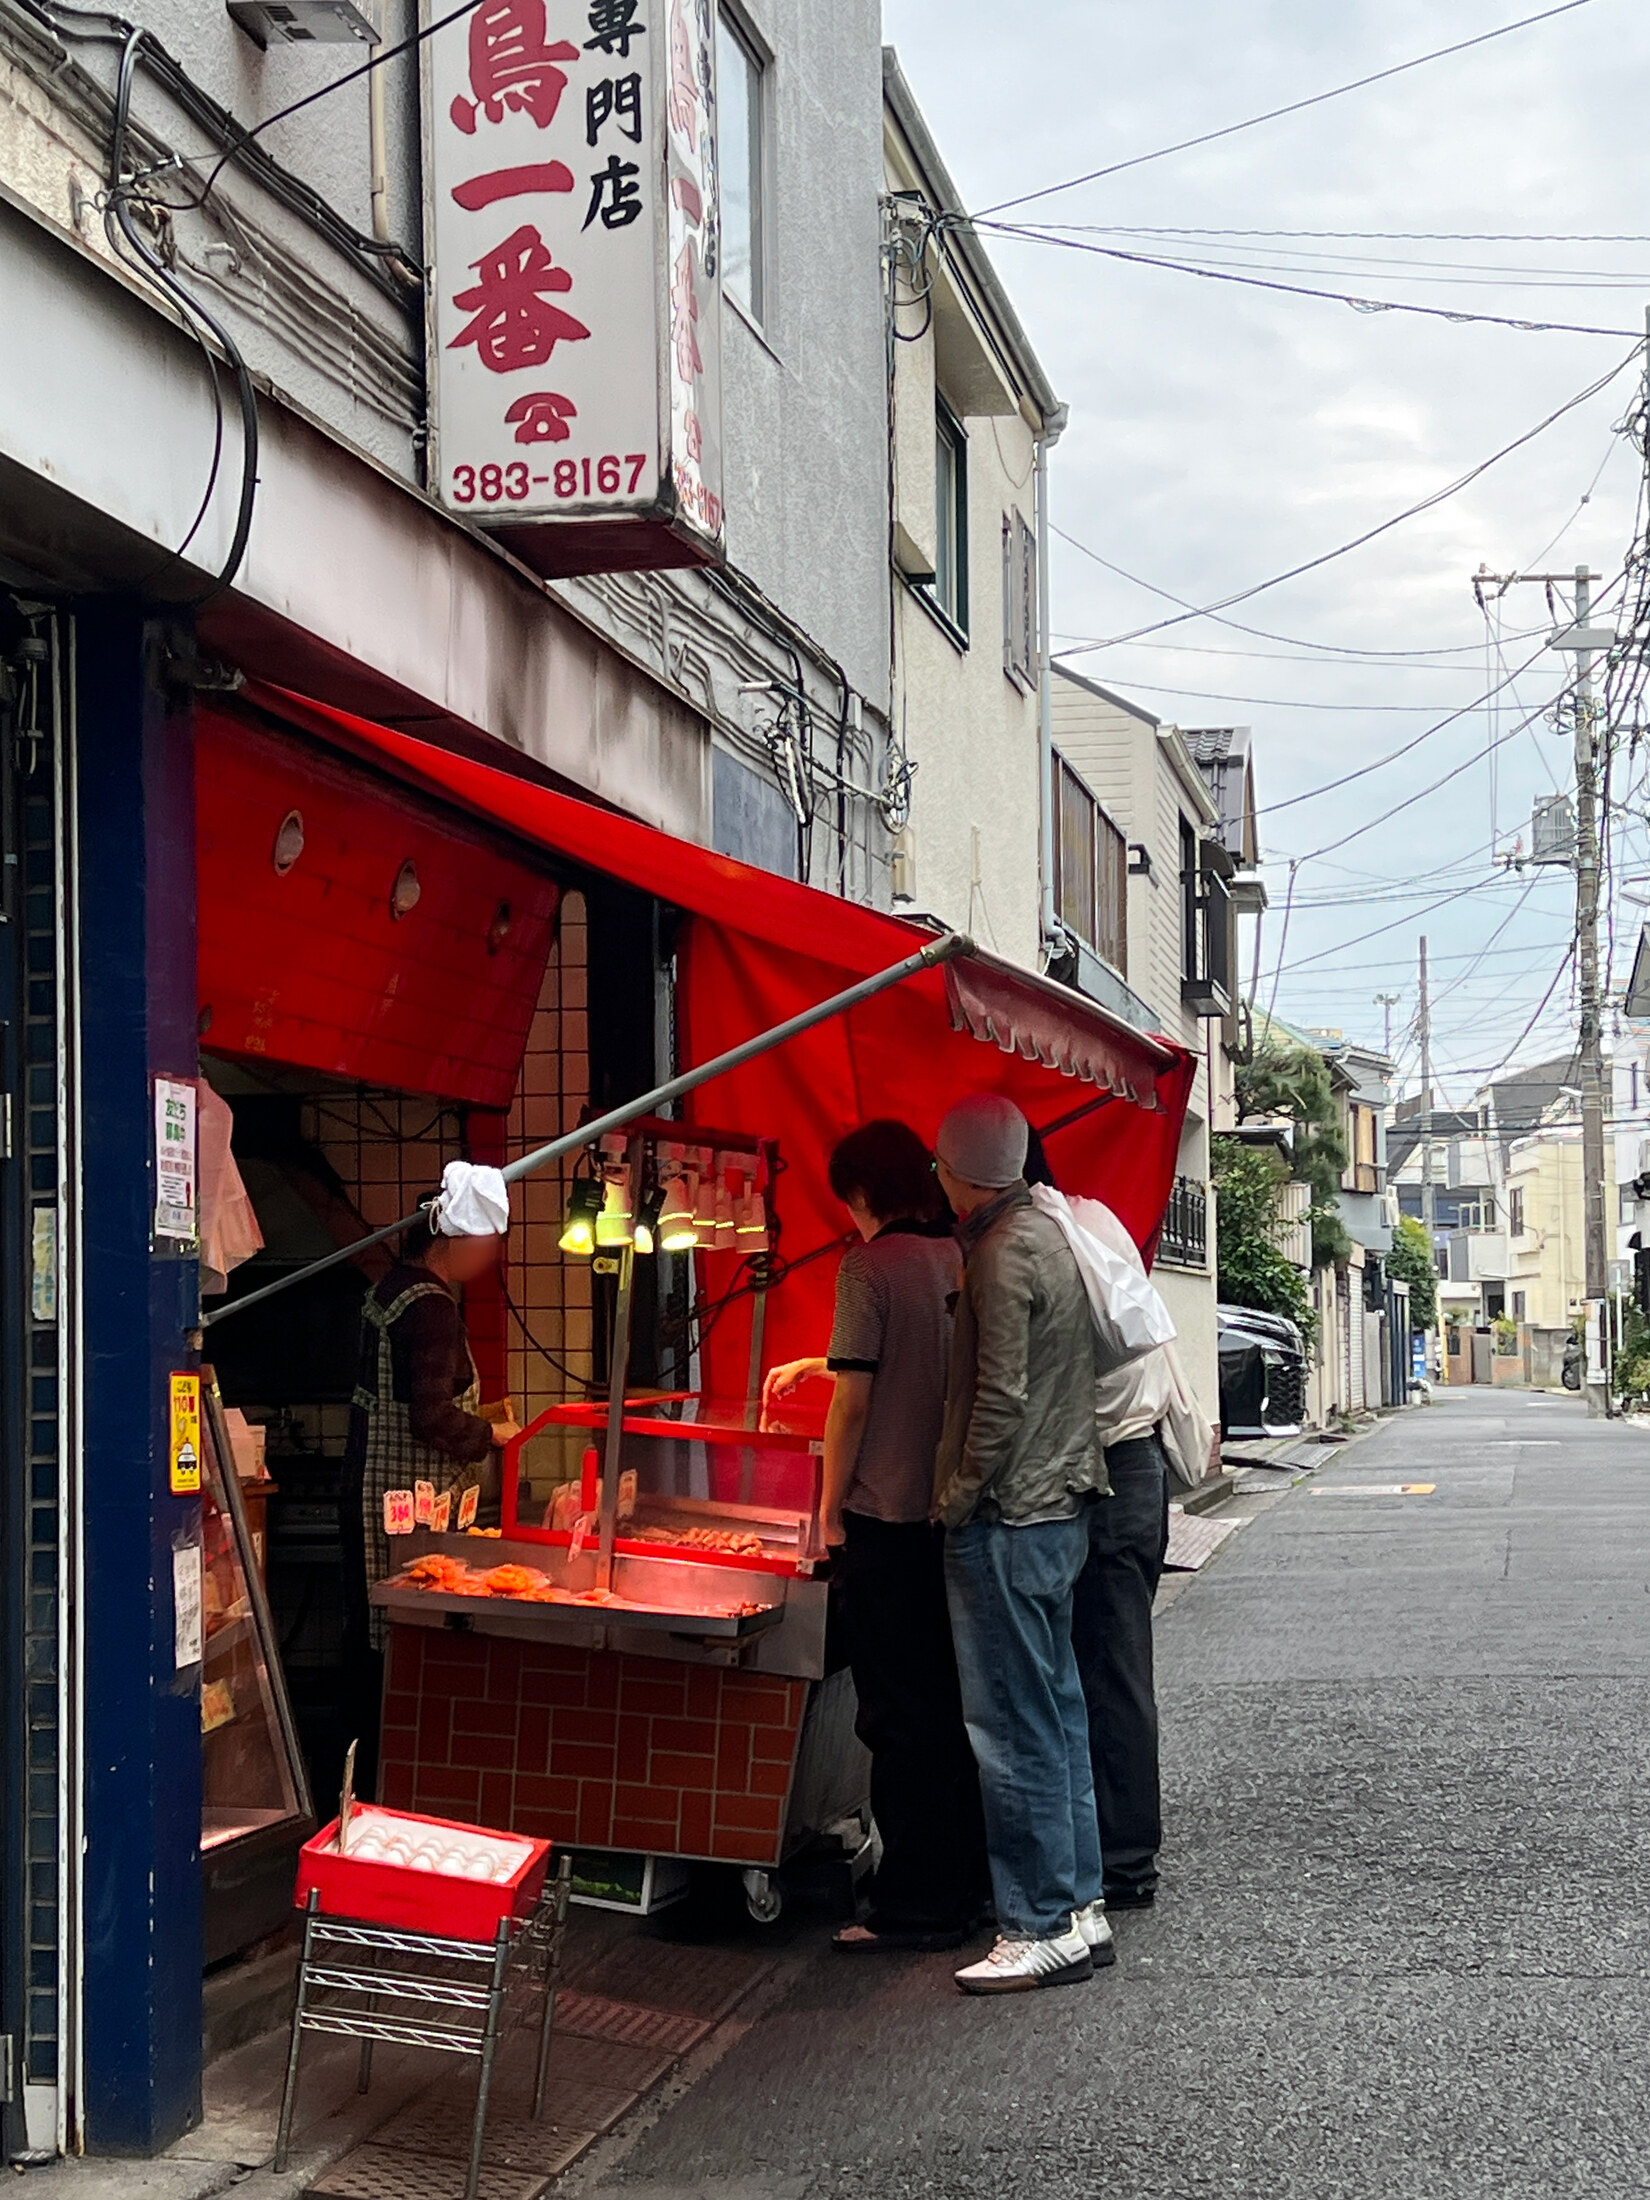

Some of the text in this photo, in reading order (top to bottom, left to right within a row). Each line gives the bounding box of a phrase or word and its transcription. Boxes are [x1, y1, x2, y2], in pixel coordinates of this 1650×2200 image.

[446, 0, 591, 374] 鳥一番
[582, 0, 647, 233] 専門店
[453, 454, 647, 503] 383-8167
